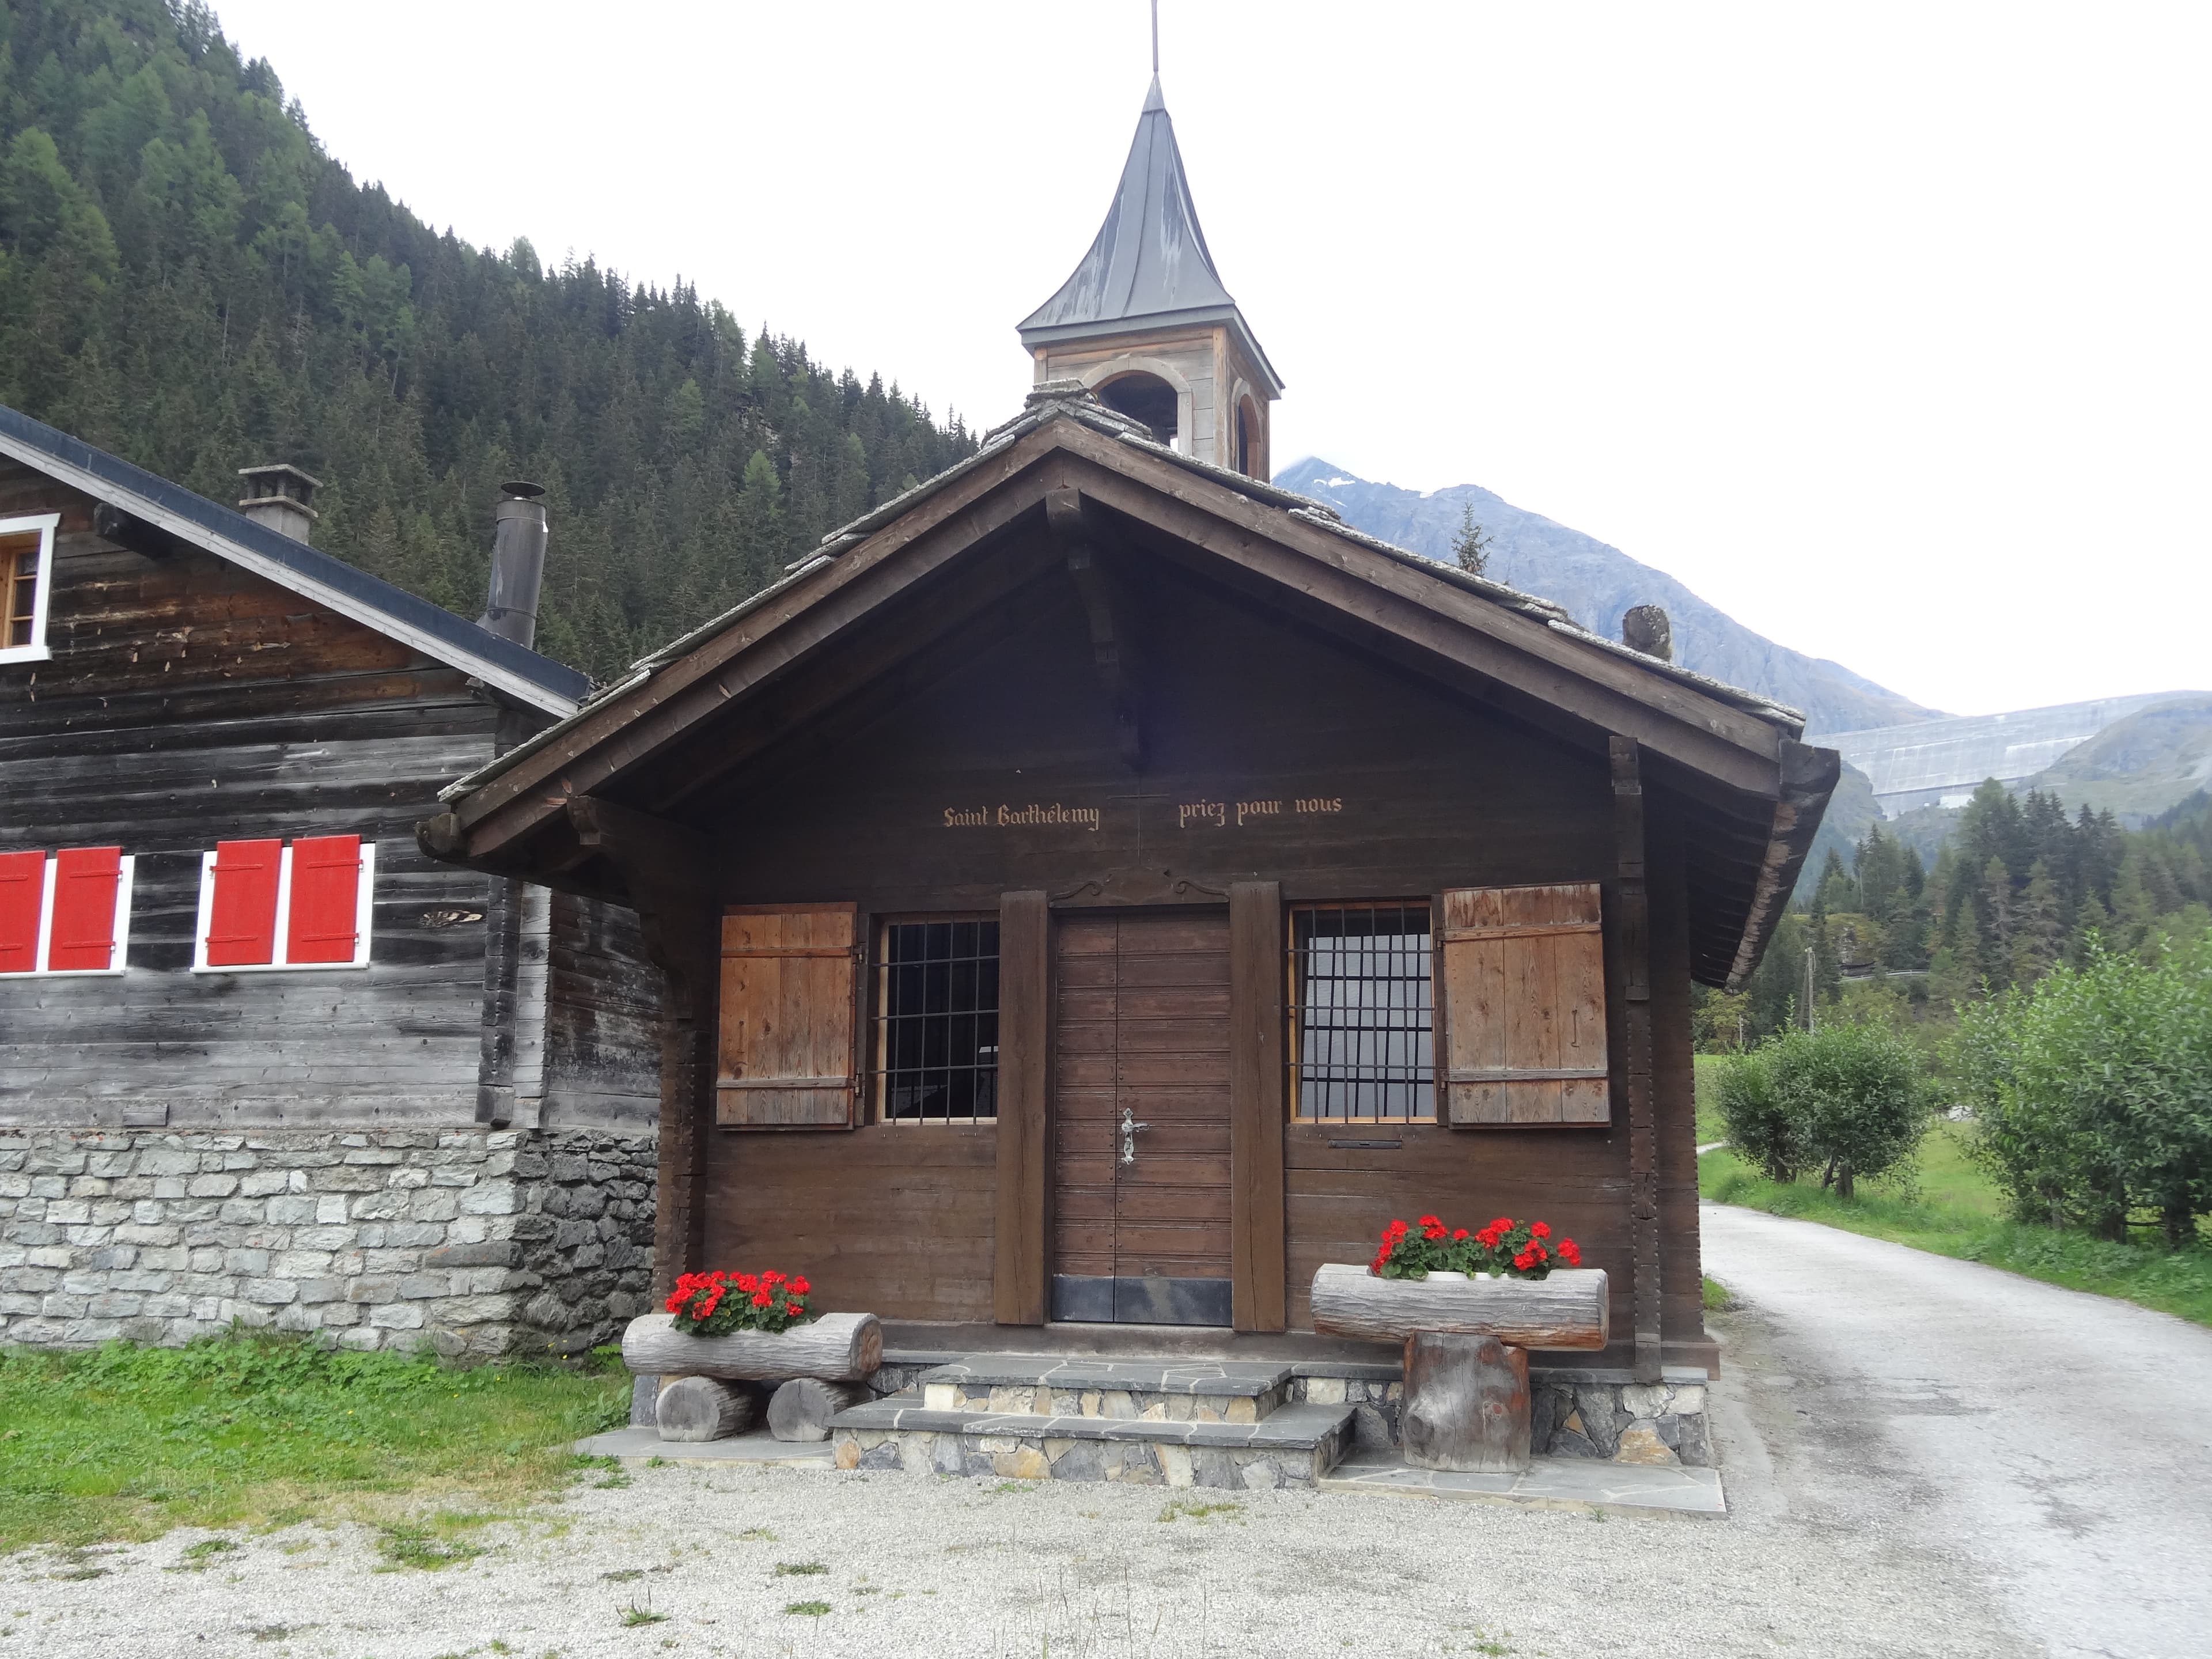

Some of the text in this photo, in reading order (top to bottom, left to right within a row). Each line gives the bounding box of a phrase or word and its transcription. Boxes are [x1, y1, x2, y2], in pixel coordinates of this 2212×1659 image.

[944, 797, 1343, 831] Saint Barthélemy priez pour nous
